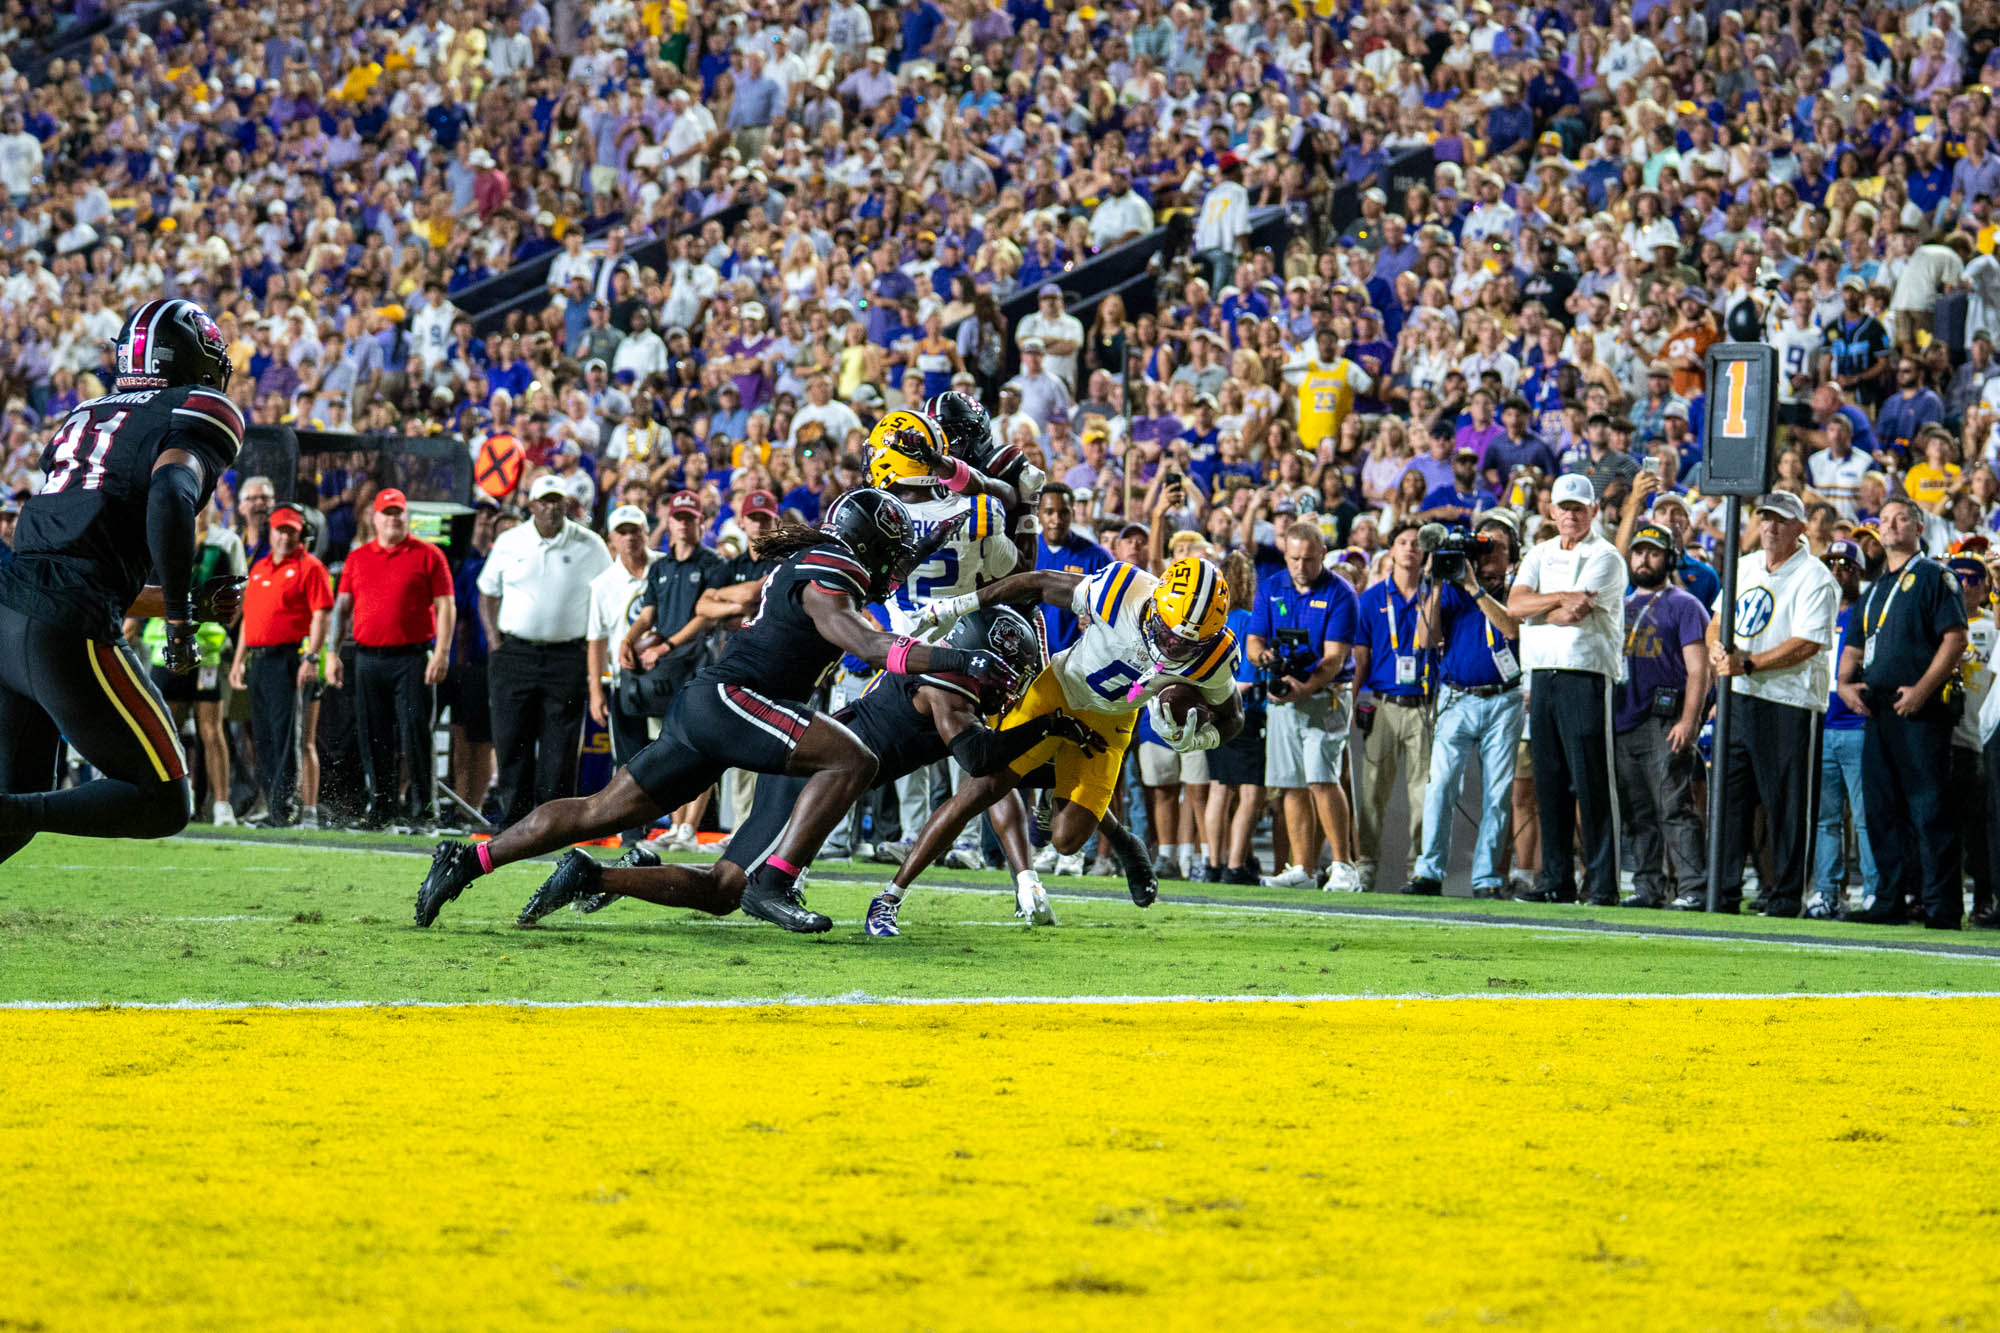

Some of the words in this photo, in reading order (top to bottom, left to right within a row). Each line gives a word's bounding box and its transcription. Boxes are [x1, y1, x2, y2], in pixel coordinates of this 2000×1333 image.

[152, 359, 160, 374] C
[1723, 360, 1748, 438] 1
[40, 409, 131, 495] 31
